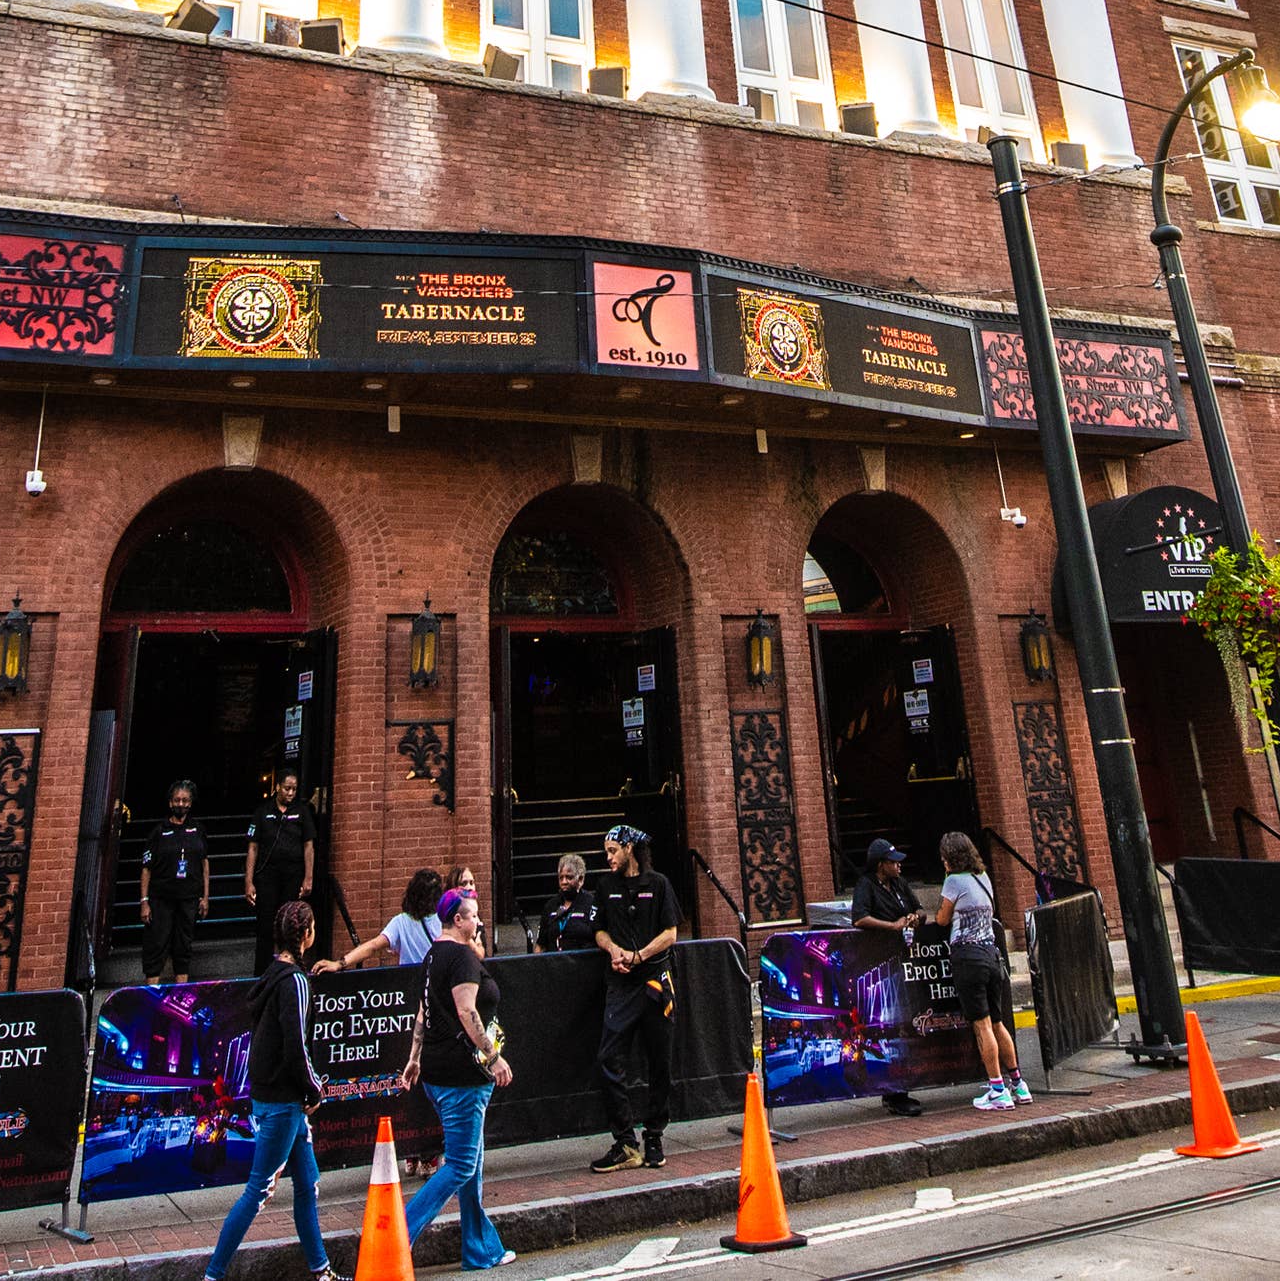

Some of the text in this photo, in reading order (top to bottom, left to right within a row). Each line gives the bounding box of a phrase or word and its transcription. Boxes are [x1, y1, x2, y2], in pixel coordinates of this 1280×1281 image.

[419, 274, 449, 284] THE
[453, 274, 506, 286] BRONX
[31, 287, 69, 305] NW
[416, 286, 514, 299] VANDOLIERS
[381, 303, 525, 322] TABERNACLE
[880, 326, 933, 344] THE BRONX
[880, 336, 938, 356] VANDOLIERS
[609, 347, 687, 366] est. 1910
[862, 349, 948, 377] TABERNACLE
[1016, 371, 1029, 385] 15
[1086, 378, 1118, 392] Street
[1122, 381, 1143, 394] NW
[1166, 536, 1206, 561] VIP
[1142, 590, 1204, 611] ENTR
[902, 962, 938, 982] EPIC
[358, 989, 406, 1009] YOUR
[313, 1014, 416, 1041] PIC EVENT
[329, 1039, 380, 1064] HERE!
